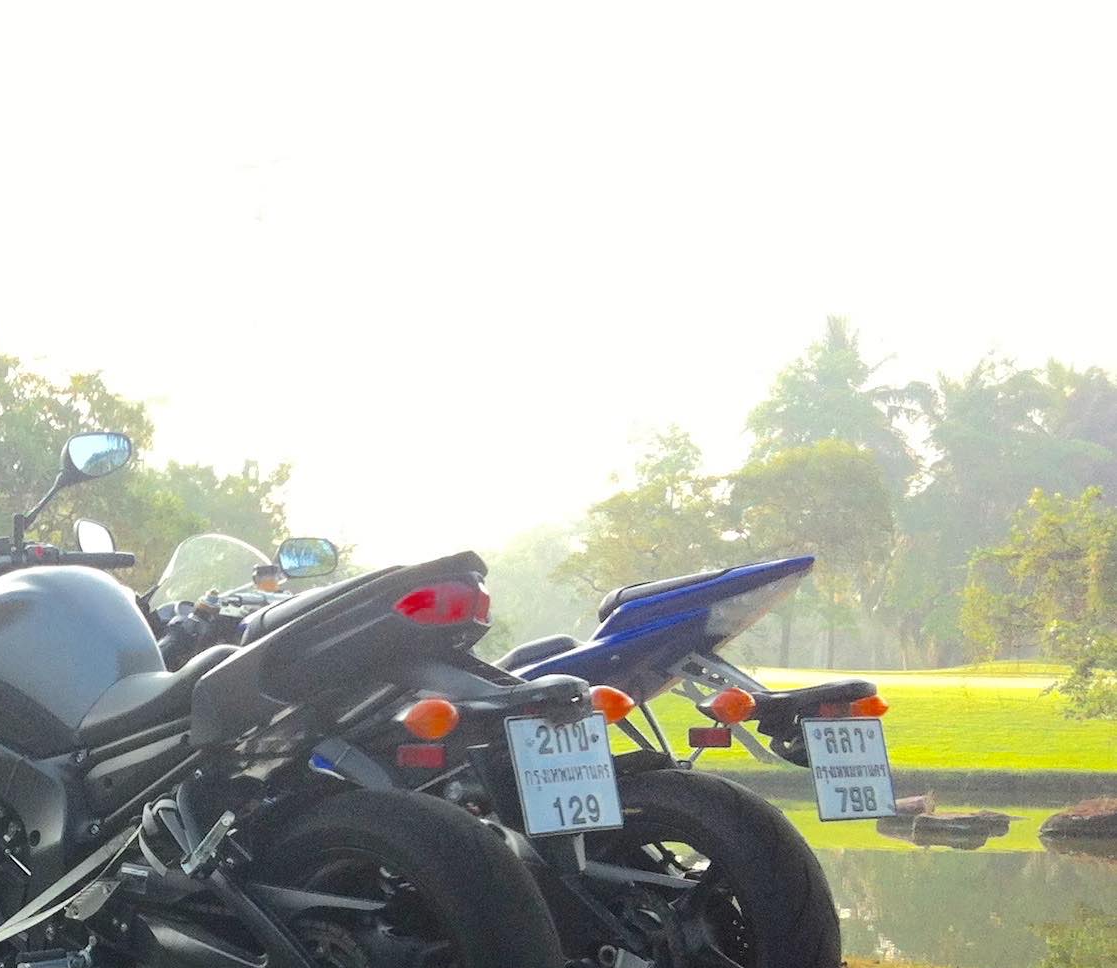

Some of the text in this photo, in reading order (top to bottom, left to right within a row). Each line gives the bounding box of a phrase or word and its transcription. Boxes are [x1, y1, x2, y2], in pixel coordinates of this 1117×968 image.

[524, 764, 611, 791] กรุงเทพมหานคร
[816, 764, 886, 784] กรุงเทพมหานคร
[553, 794, 600, 827] 129
[835, 785, 878, 812] 798
